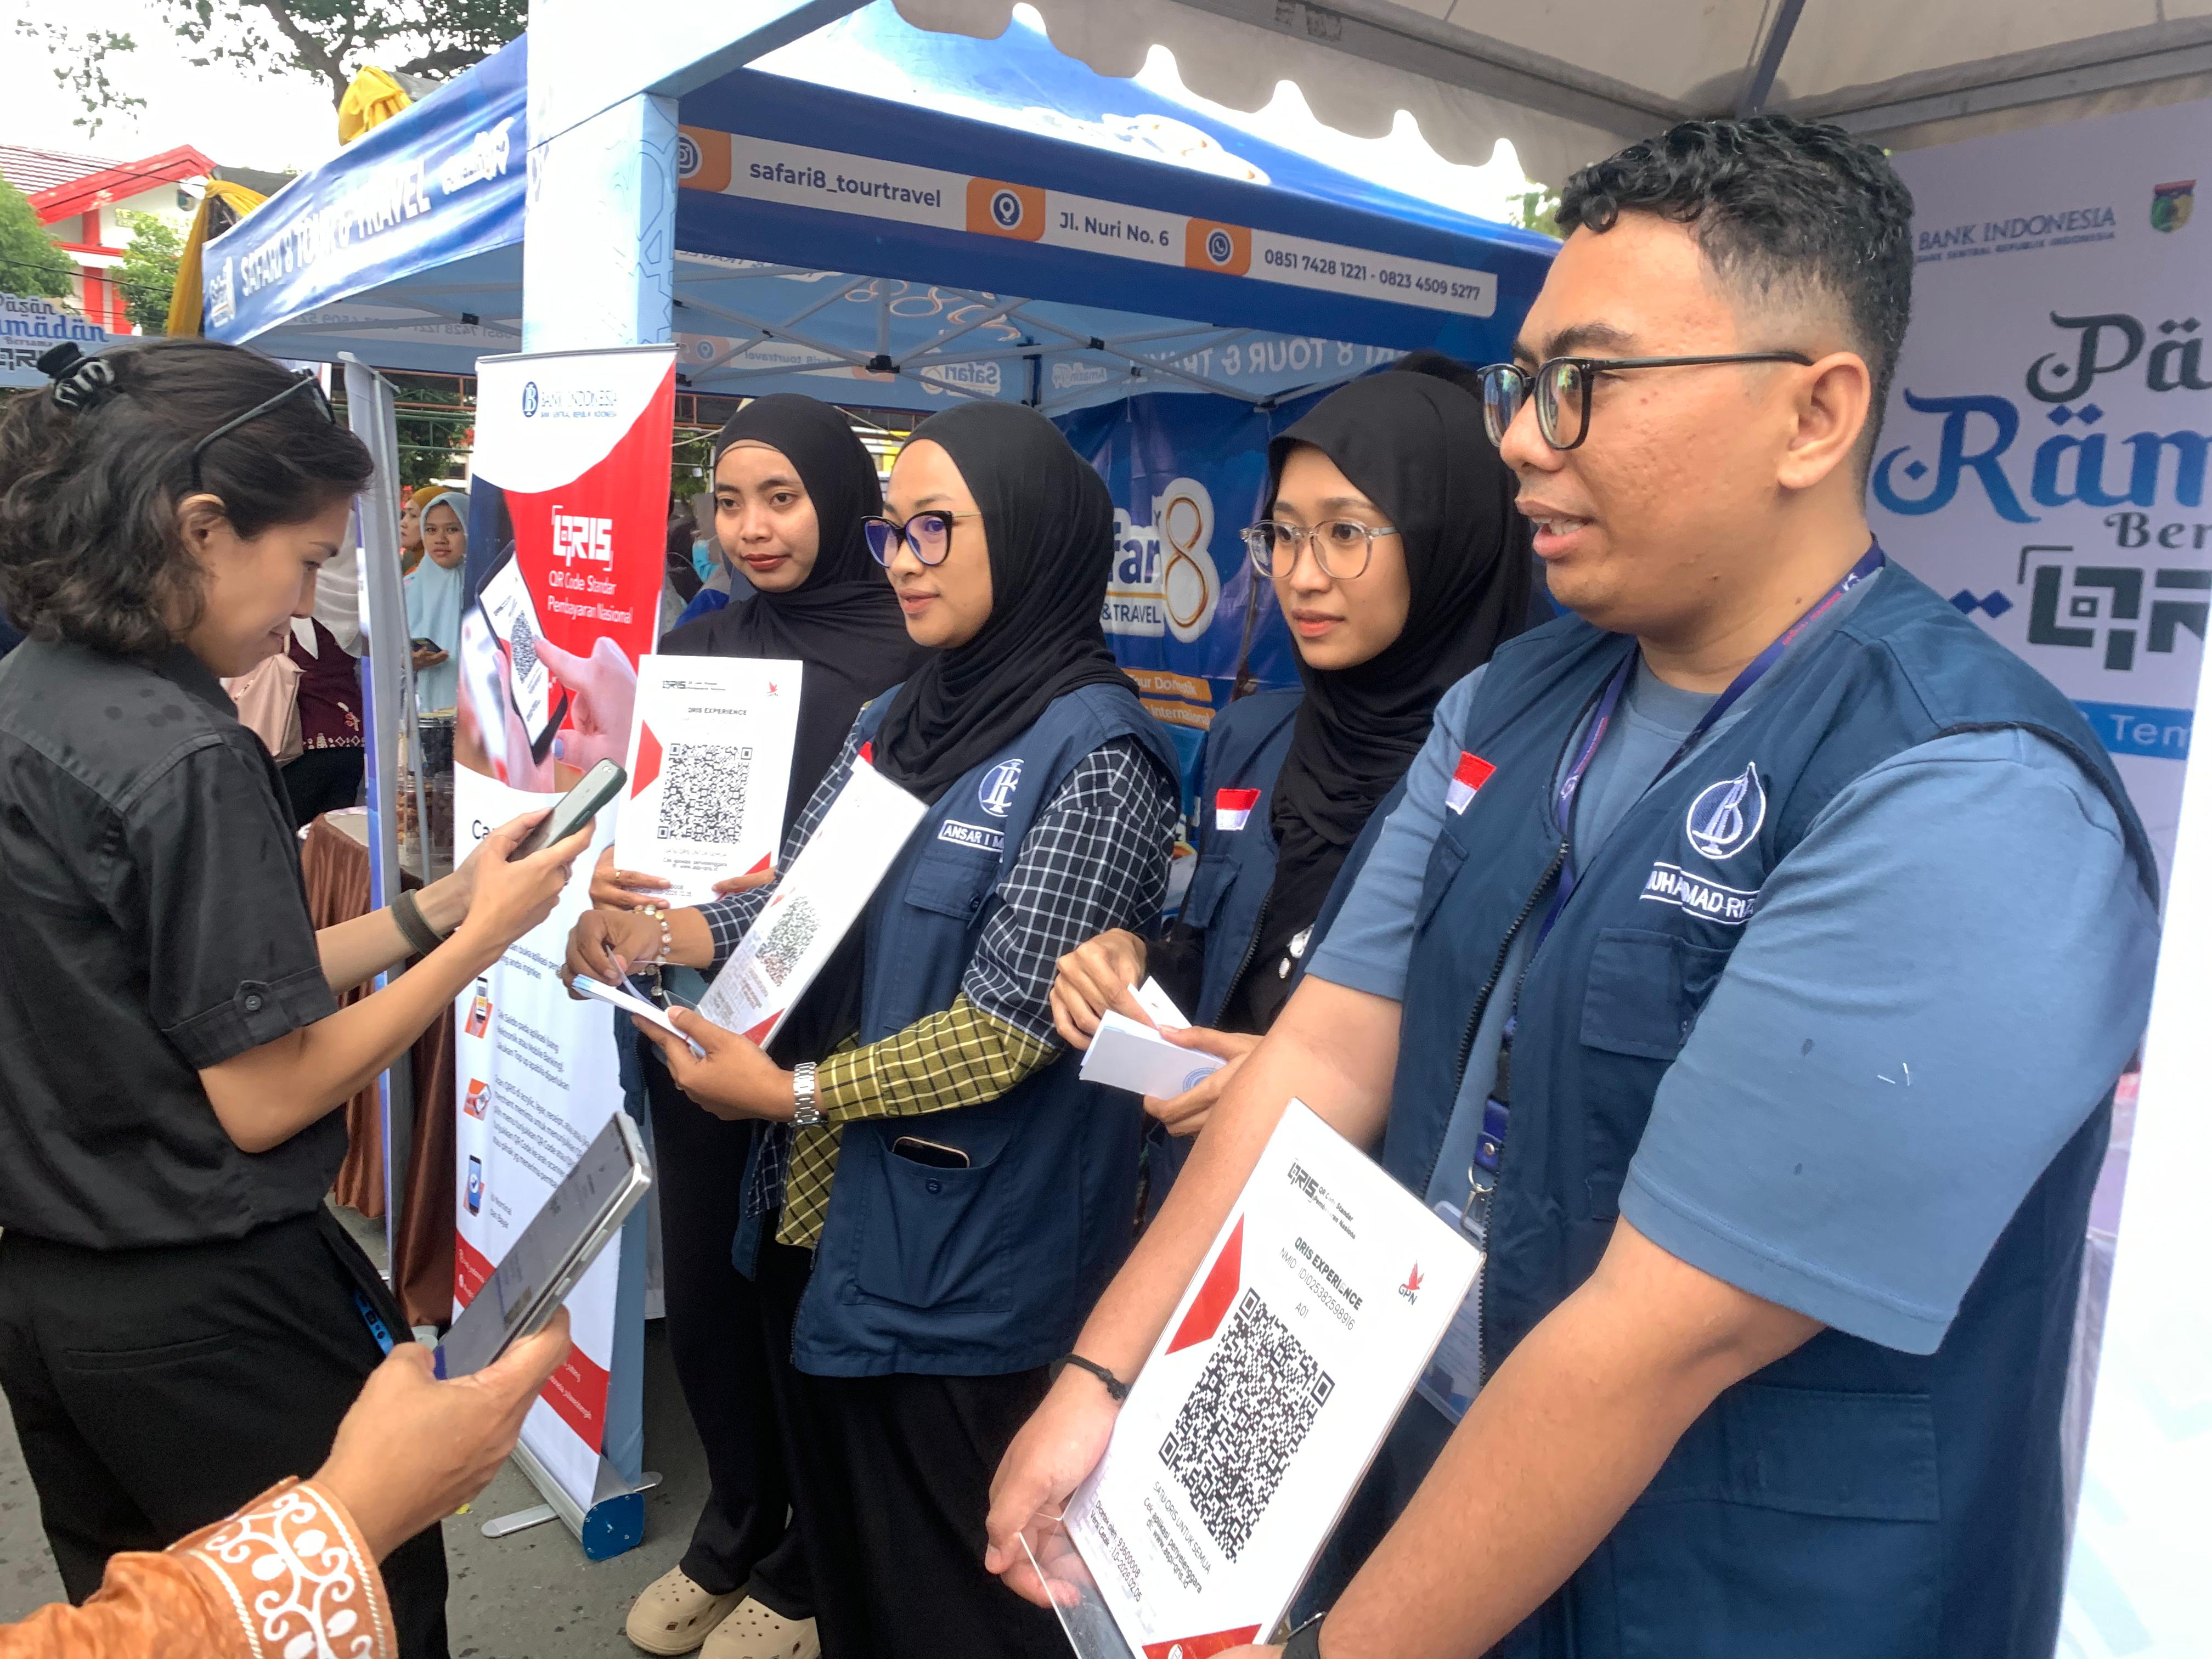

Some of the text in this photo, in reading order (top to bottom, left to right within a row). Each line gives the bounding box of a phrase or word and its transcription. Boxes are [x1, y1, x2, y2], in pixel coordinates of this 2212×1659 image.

[749, 162, 942, 208] safari8_tourtravel
[1060, 212, 1170, 247] Jl. Nuri No. 6
[1918, 206, 2117, 251] BANK INDONESIA
[1265, 249, 1298, 269] 0851
[1302, 254, 1337, 275] 7428
[1340, 261, 1367, 281] 1221
[1379, 269, 1412, 289] 0823
[1415, 275, 1448, 296] 4509
[1451, 282, 1481, 302] 5277
[549, 570, 565, 588] QR
[565, 572, 585, 591] Code
[1113, 604, 1162, 624] TRAVEL
[472, 819, 495, 840] Ca
[943, 824, 983, 843] ANSAR
[1318, 1186, 1326, 1197] QR
[1294, 1236, 1363, 1311] QRIS EXPERIENCE
[1295, 1301, 1309, 1319] A01
[1398, 1283, 1418, 1306] GPN
[1090, 1509, 1102, 1531] Versi
[1098, 1526, 1110, 1548] Cetak
[1095, 1499, 1110, 1525] Dicetak
[1117, 1537, 1141, 1579] 93600008
[1143, 1497, 1203, 1594] Cek aplikasi penyelenggara
[1153, 1481, 1211, 1575] SATU QRIS UNTUK SEMUA
